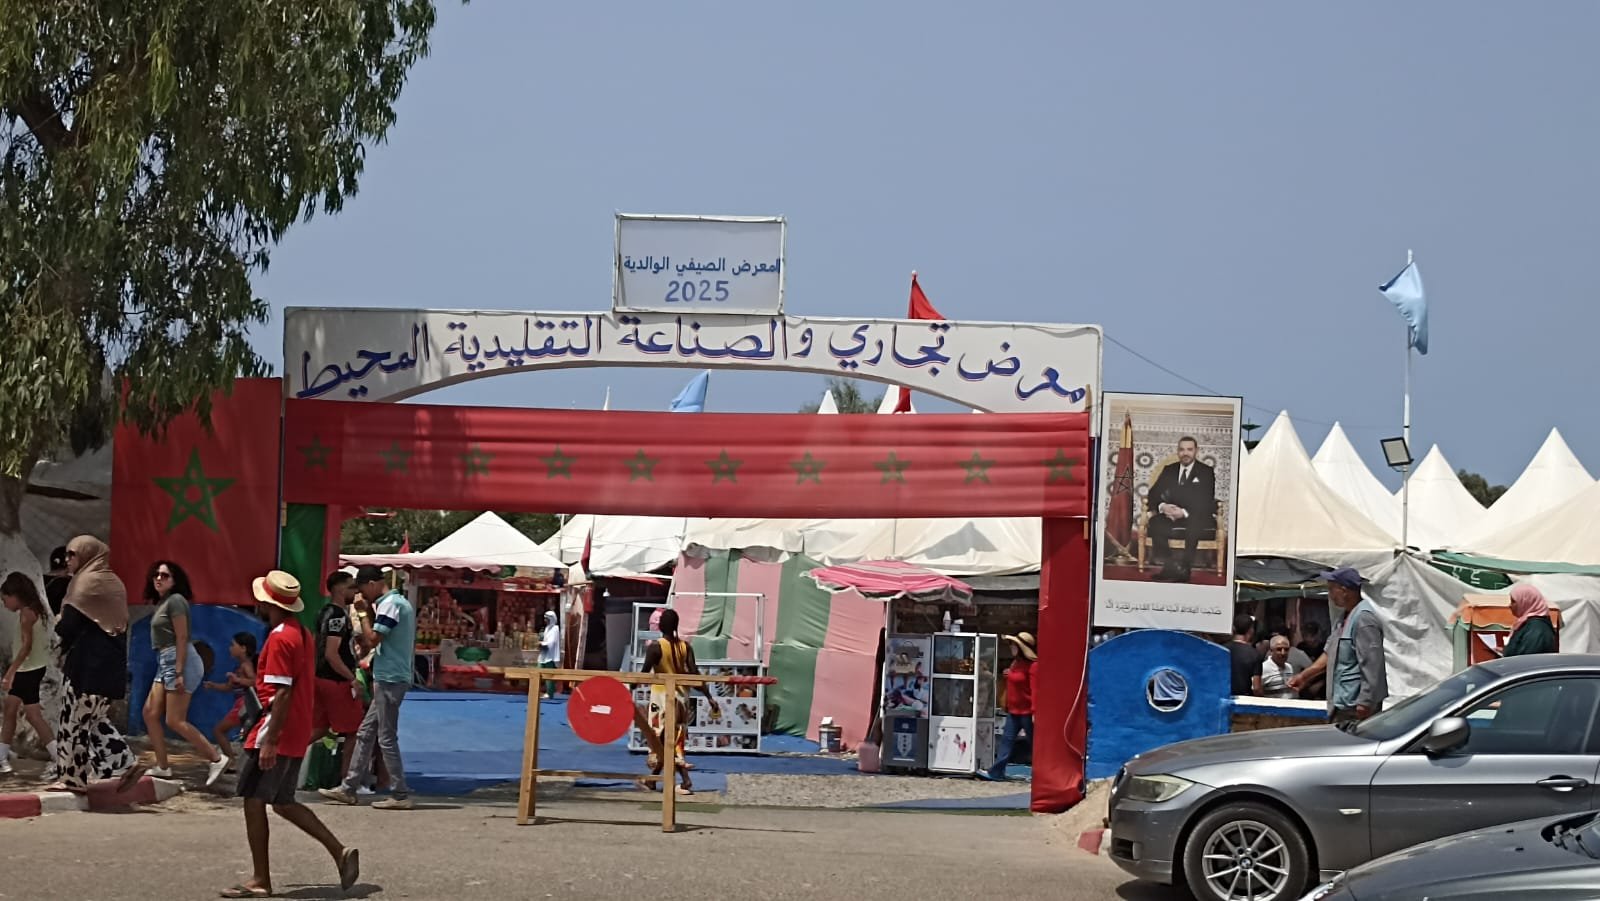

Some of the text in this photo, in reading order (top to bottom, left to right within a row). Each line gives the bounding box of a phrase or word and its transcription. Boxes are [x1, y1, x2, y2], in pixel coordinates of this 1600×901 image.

[623, 255, 781, 277] المعرض الصيفي الوالدية
[664, 280, 730, 303] 2025
[295, 322, 430, 399] المحيط
[443, 315, 603, 372] التقليدية
[828, 322, 952, 377] تجاري
[957, 342, 1086, 404] معرض
